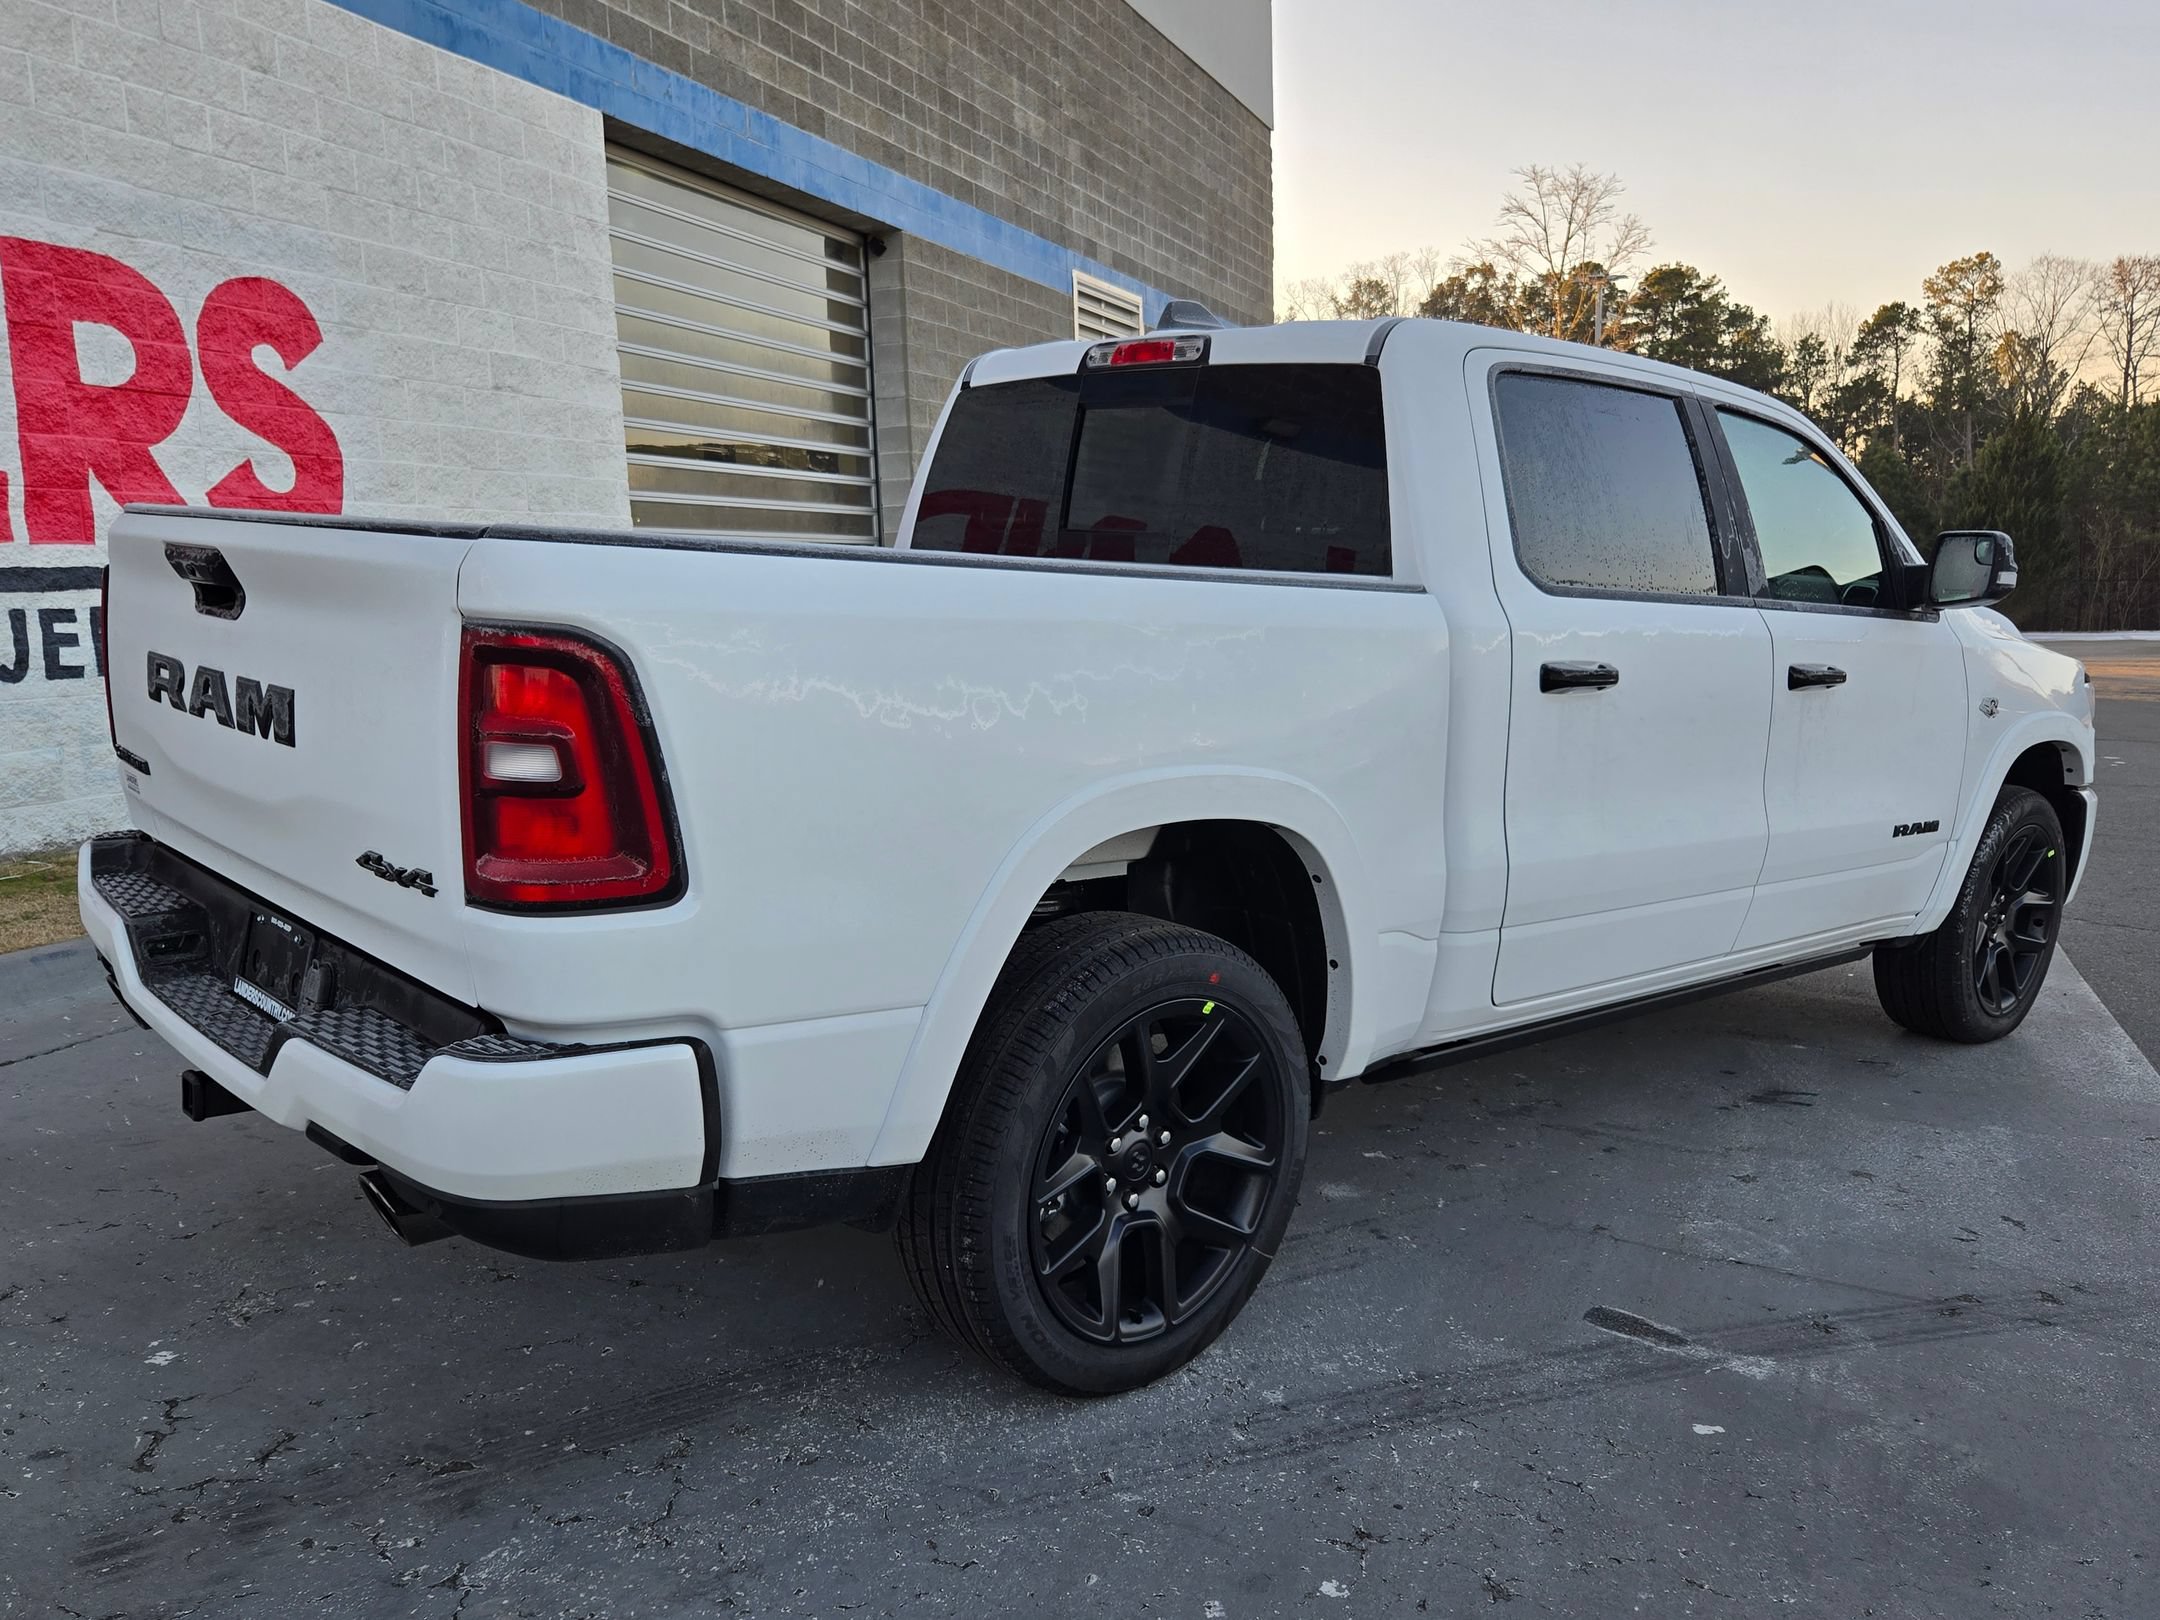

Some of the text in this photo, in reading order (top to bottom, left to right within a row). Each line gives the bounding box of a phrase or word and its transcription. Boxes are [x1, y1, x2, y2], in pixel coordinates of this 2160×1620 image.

[0, 236, 344, 545] RS
[0, 608, 105, 684] JE
[147, 650, 296, 748] RAM
[1892, 820, 1940, 838] RAM
